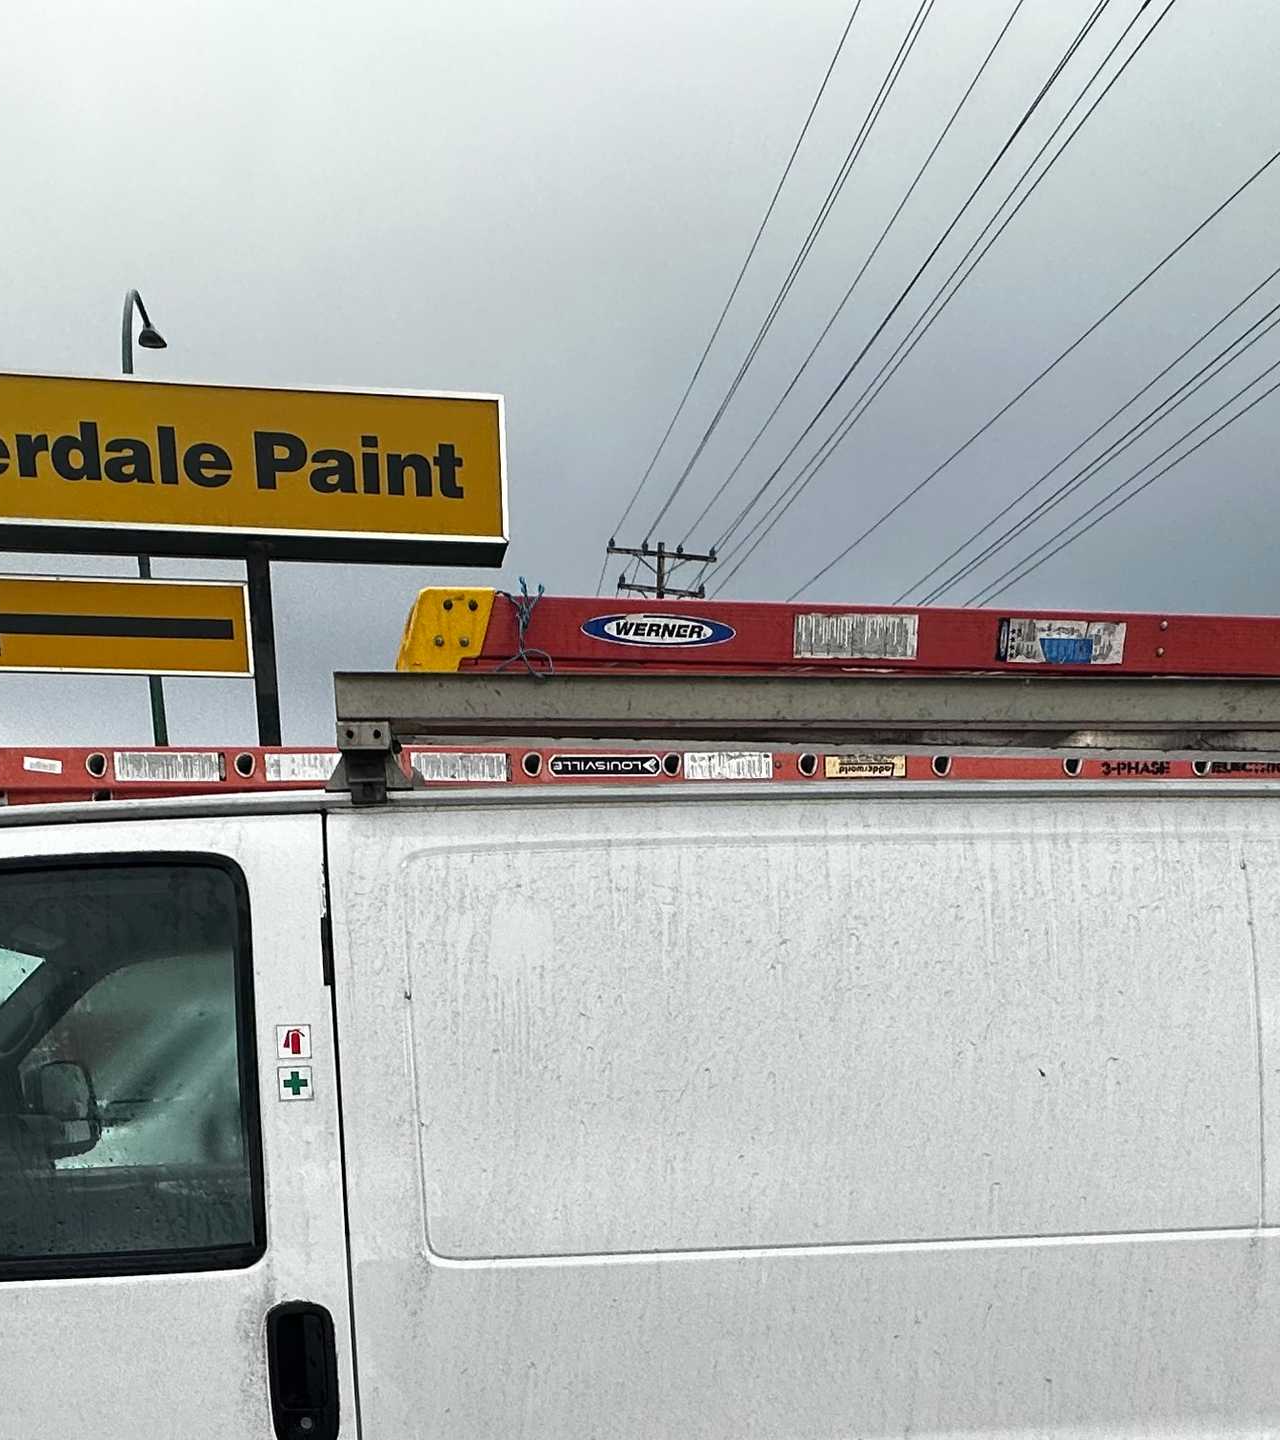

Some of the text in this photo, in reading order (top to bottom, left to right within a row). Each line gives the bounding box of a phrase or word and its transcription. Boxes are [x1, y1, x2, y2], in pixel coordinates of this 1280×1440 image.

[253, 430, 464, 499] Paint
[615, 621, 705, 639] WERNER
[553, 761, 644, 772] LOUISVILLE
[1101, 761, 1170, 776] 3-PHASE
